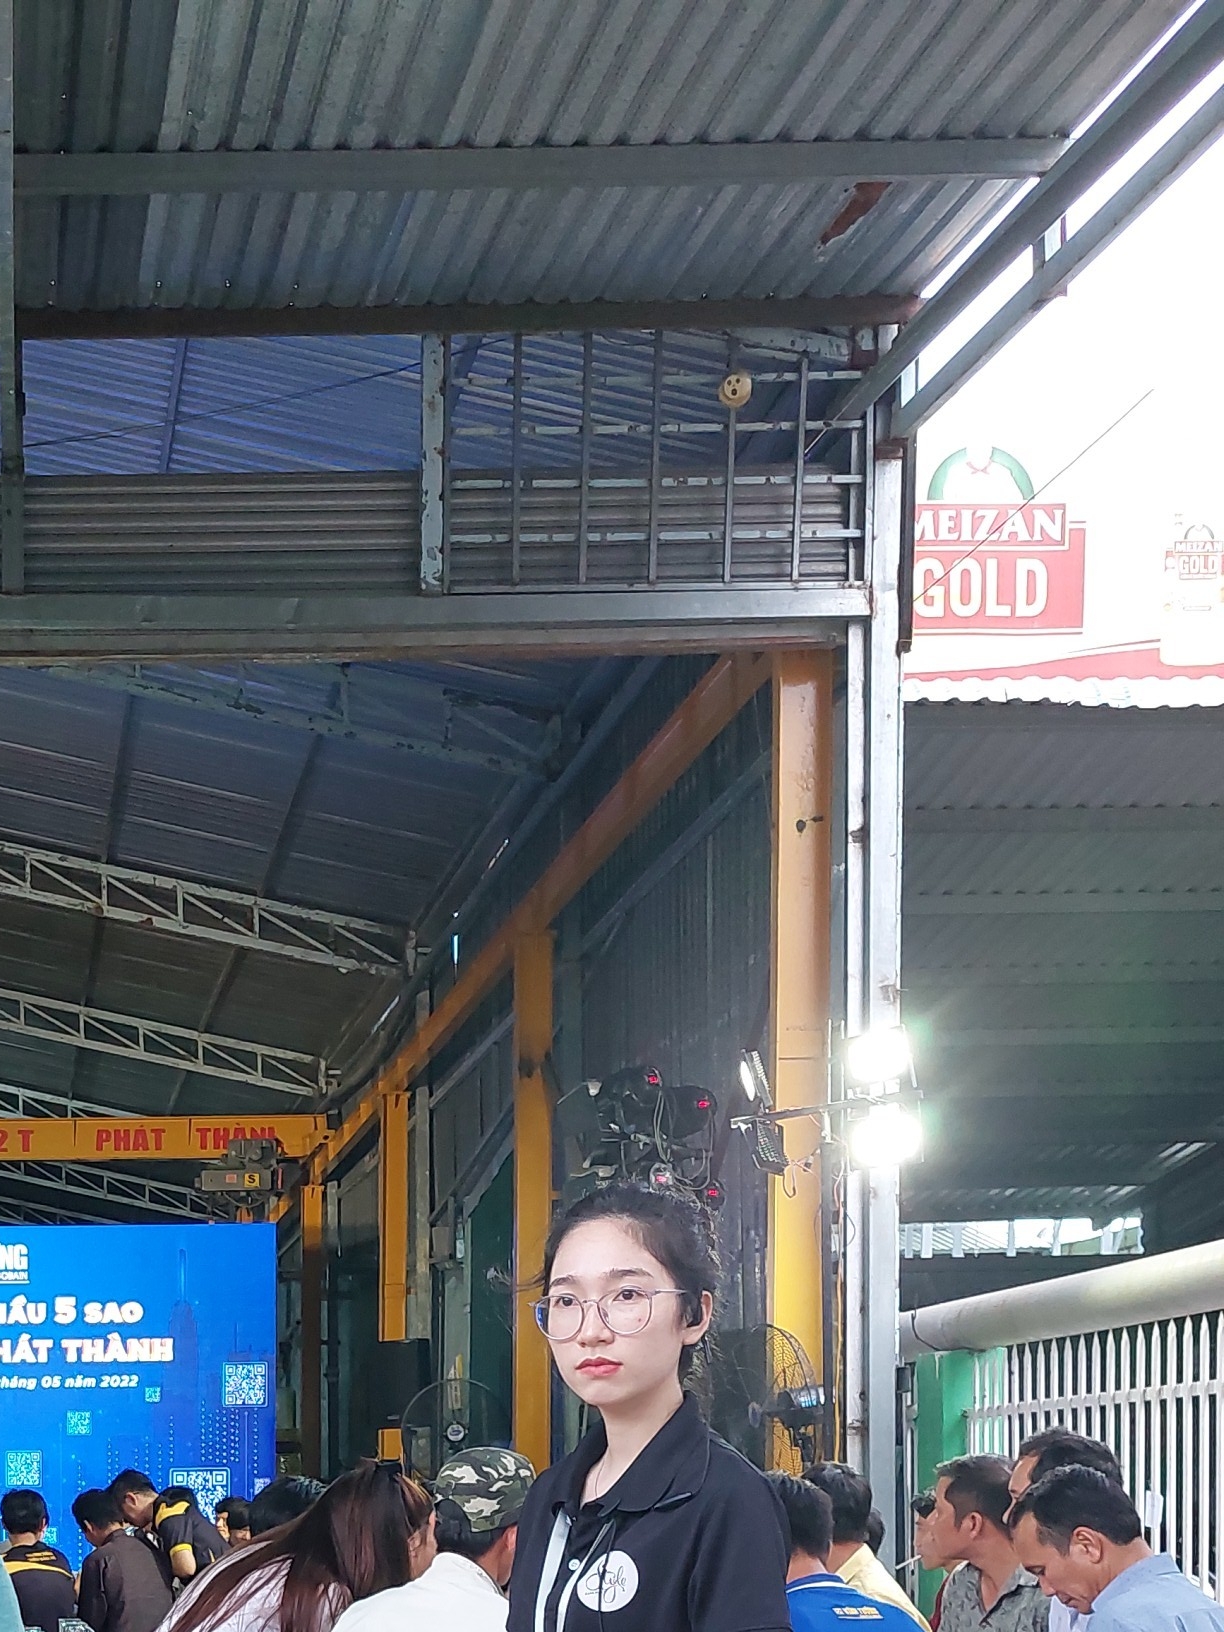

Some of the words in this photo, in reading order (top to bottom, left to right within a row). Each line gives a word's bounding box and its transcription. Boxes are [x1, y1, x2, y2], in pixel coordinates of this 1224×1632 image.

[915, 508, 1065, 542] MEIZAN
[1179, 555, 1217, 574] GOLD
[914, 557, 1048, 618] GOLD
[18, 1129, 36, 1153] T
[96, 1125, 166, 1151] PHÁT
[54, 1296, 77, 1325] 5
[83, 1301, 144, 1324] SAO
[61, 1332, 174, 1363] THÀNH
[41, 1376, 62, 1389] 05
[100, 1375, 139, 1388] 2022
